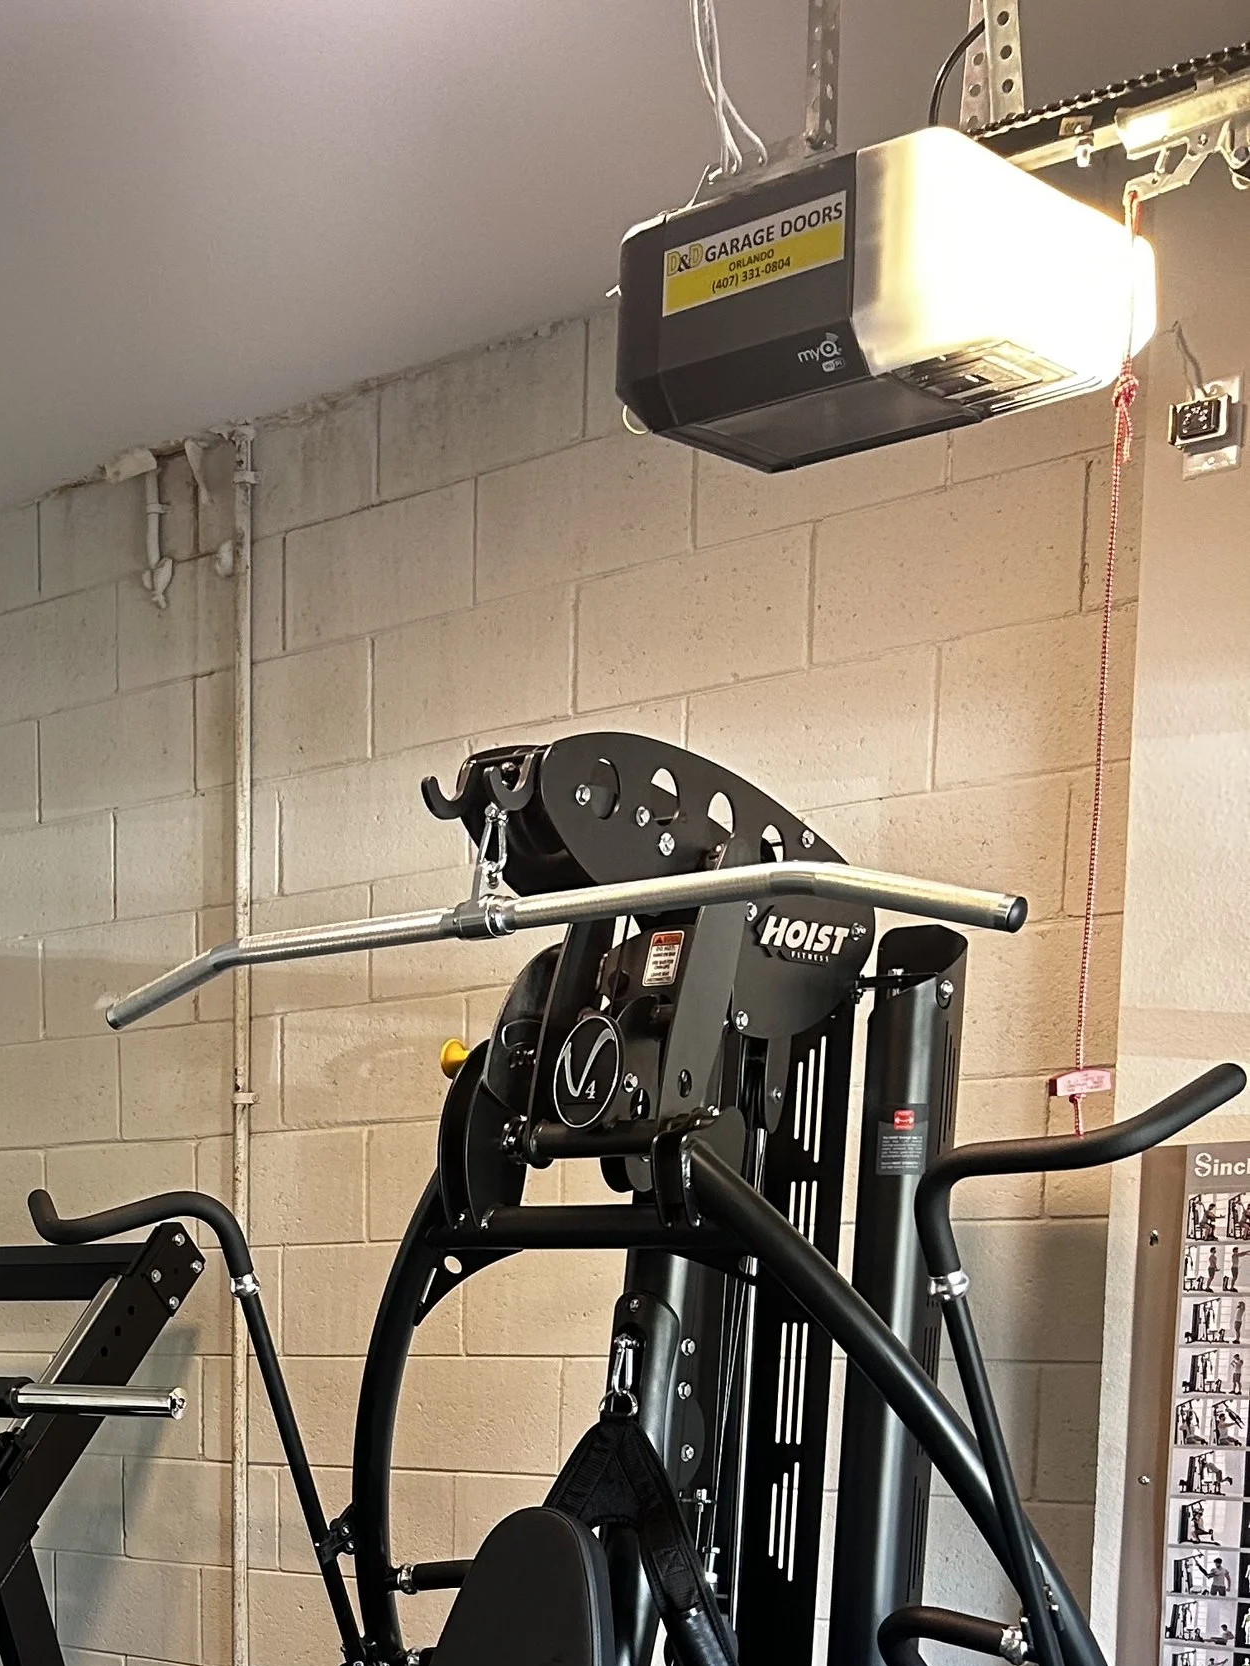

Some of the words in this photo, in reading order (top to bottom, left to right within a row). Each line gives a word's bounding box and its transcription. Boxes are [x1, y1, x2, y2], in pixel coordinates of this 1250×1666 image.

[666, 242, 703, 276] D&D
[704, 225, 775, 263] GARAGE
[780, 201, 843, 238] DOORS
[711, 276, 739, 294] (407)
[741, 256, 791, 282] 331-0804
[728, 248, 775, 272] ORLANDO
[759, 915, 850, 955] HOIST
[791, 950, 829, 963] FITNESS
